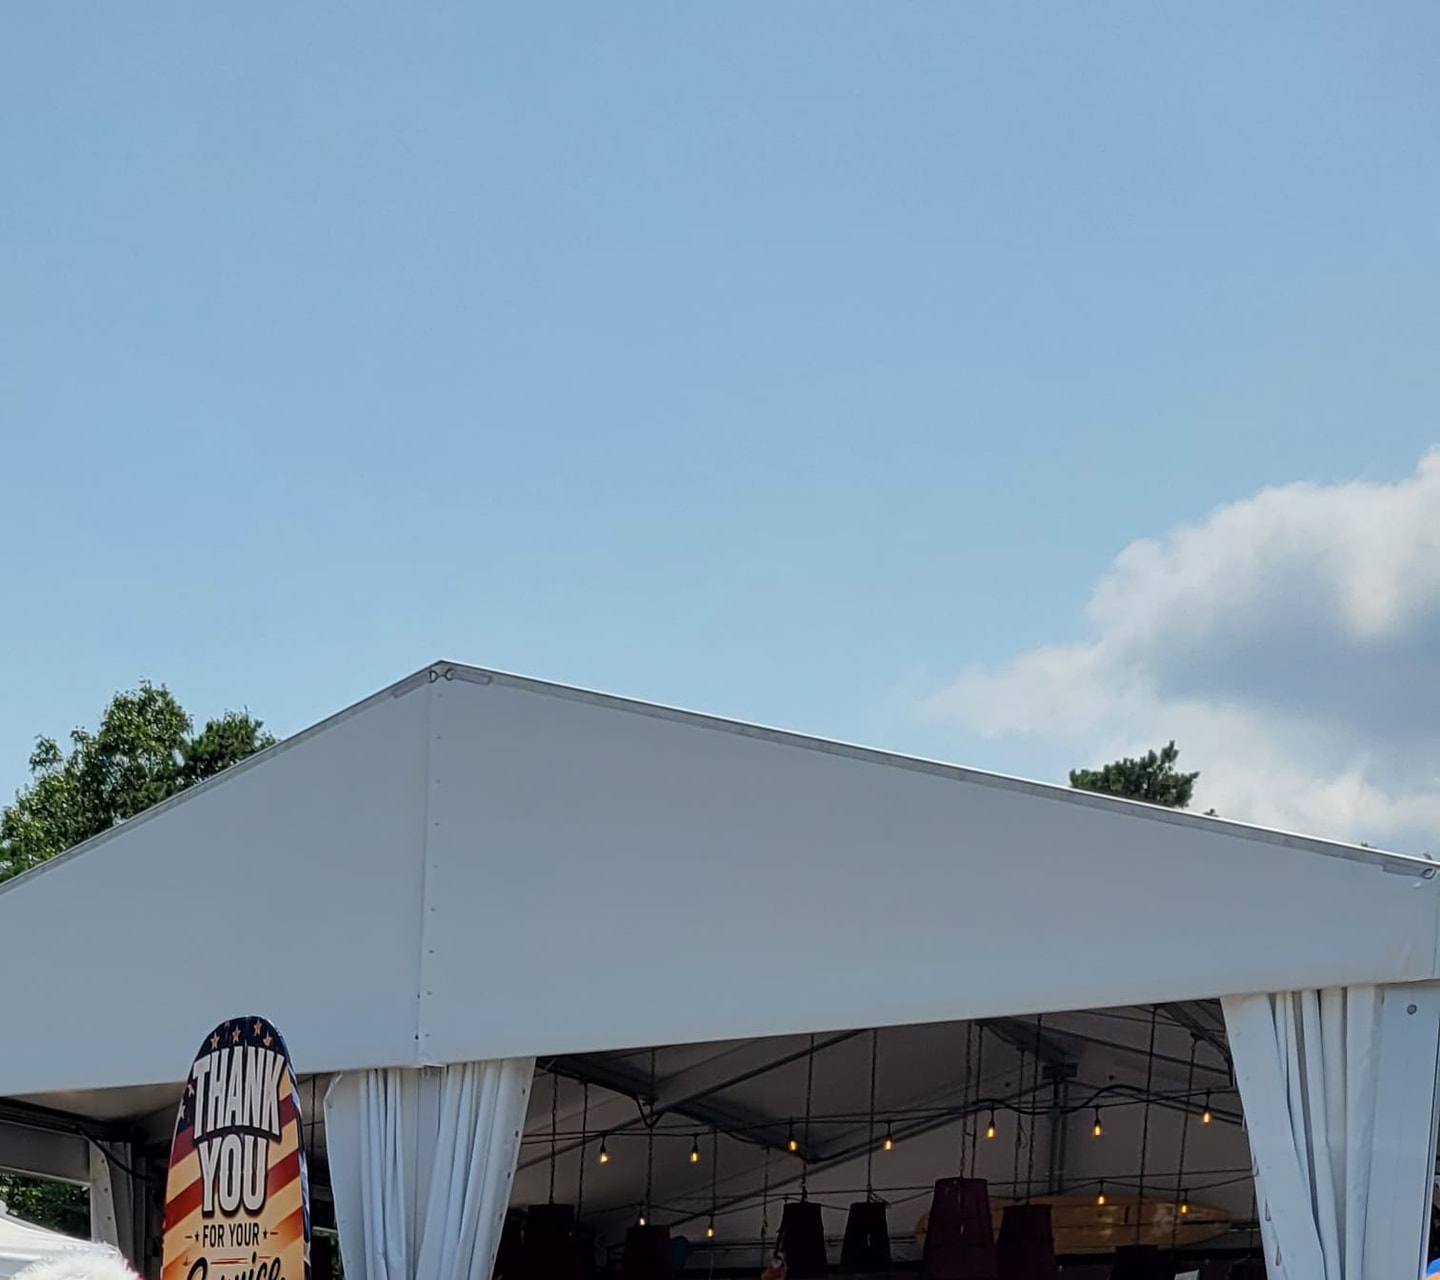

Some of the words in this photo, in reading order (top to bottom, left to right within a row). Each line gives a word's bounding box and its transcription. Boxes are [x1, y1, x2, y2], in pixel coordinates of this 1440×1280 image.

[193, 1045, 285, 1140] THANK
[198, 1133, 267, 1212] YOU
[202, 1224, 225, 1249] FOR
[228, 1222, 260, 1248] YOUR
